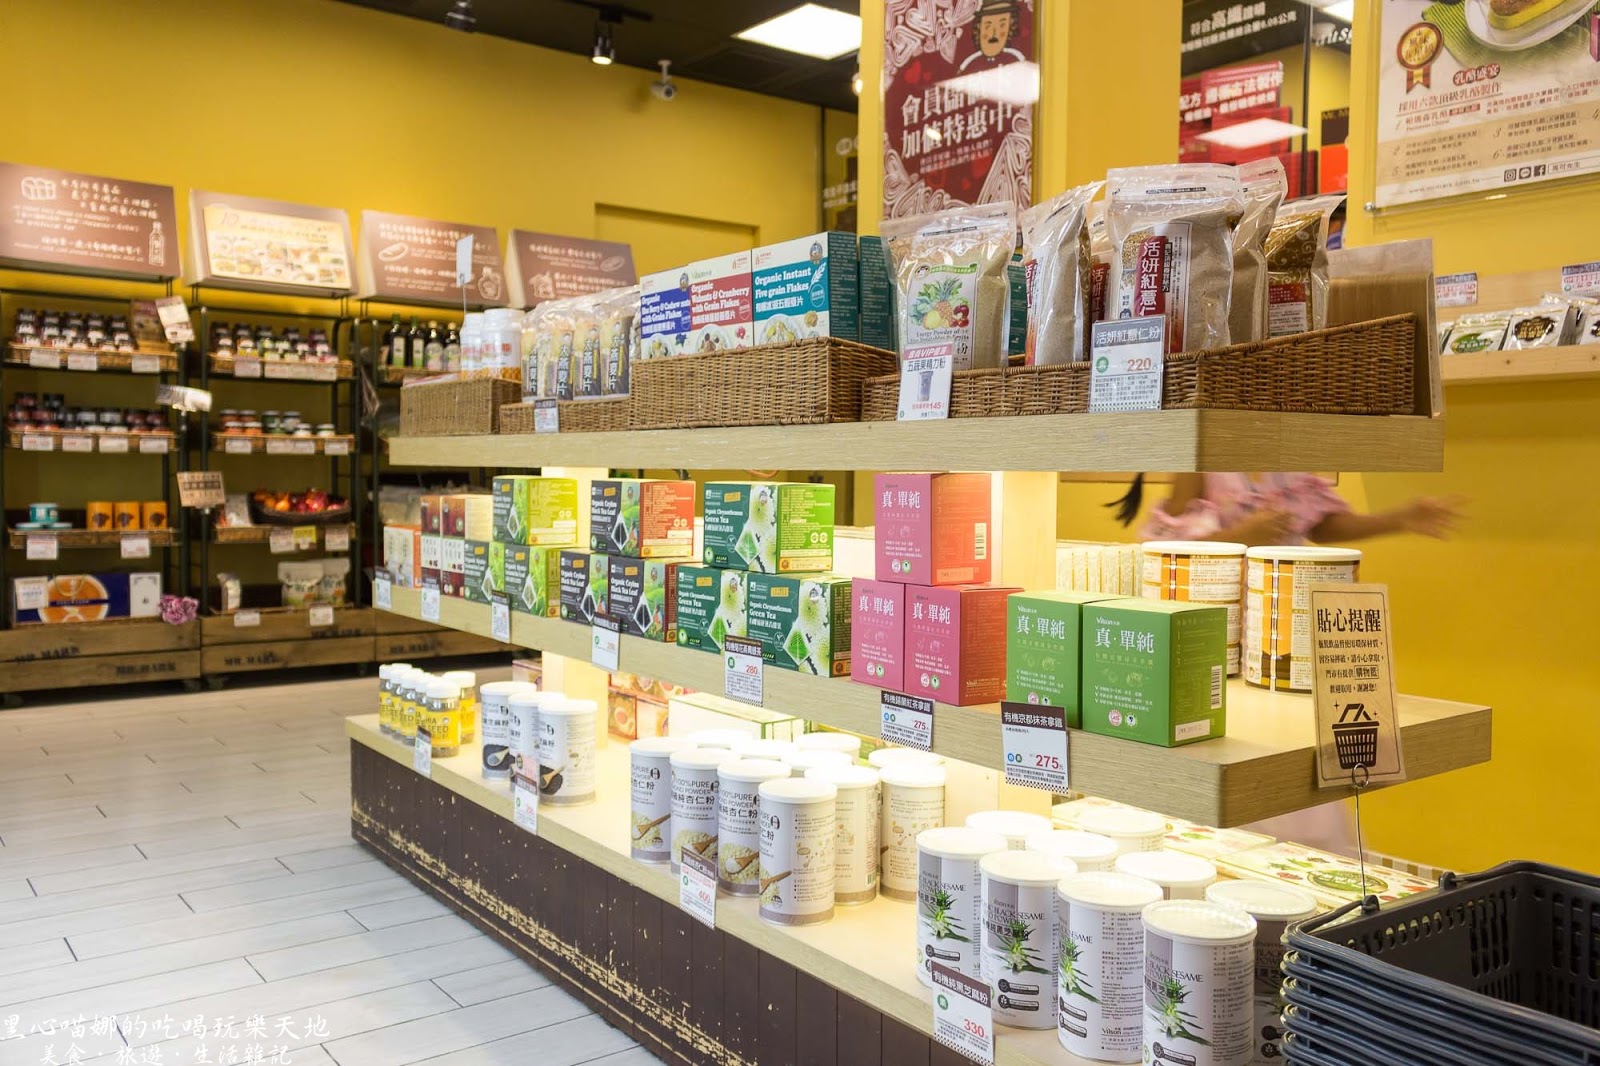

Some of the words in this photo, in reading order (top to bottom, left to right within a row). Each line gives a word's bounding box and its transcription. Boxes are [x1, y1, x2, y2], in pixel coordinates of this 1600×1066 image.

[755, 273, 782, 286] Organic
[783, 267, 811, 280] Instant
[1139, 241, 1161, 317] 活妍紅薏仁
[691, 282, 714, 293] Organic
[719, 287, 750, 300] Cranberry
[755, 288, 767, 299] Five
[768, 285, 786, 298] grain
[787, 282, 809, 293] Flakes
[691, 303, 704, 313] with
[704, 301, 720, 311] Grain
[720, 298, 740, 309] Flakes
[933, 329, 953, 338] Powder
[1096, 326, 1161, 345] 活妍紅薏仁粉
[582, 339, 593, 392] 大燕麥片
[608, 334, 619, 390] 大燕麥片
[907, 357, 946, 373] 五蔬果精力粉
[1127, 357, 1151, 372] 220
[557, 345, 570, 396] 大燕麥片
[705, 515, 719, 523] Green
[678, 597, 692, 606] Green
[693, 599, 702, 607] Tea
[749, 608, 765, 618] Green
[766, 611, 776, 619] Tea
[1096, 616, 1113, 625] Vilson
[1317, 608, 1382, 632] 貼心提醒
[746, 665, 759, 675] 280
[1355, 667, 1378, 678] 購物籃
[914, 720, 926, 731] 275
[1003, 712, 1063, 728] 有機京都抹茶拿鐵
[1036, 754, 1059, 769] 275
[941, 882, 967, 893] SESAME
[994, 907, 1017, 918] BLACK
[1018, 911, 1045, 922] SESAME
[1172, 972, 1204, 983] SESAME
[933, 970, 989, 1005] 有機純黑芝麻粉
[964, 1018, 985, 1038] 330
[1102, 1027, 1122, 1035] Vilson
